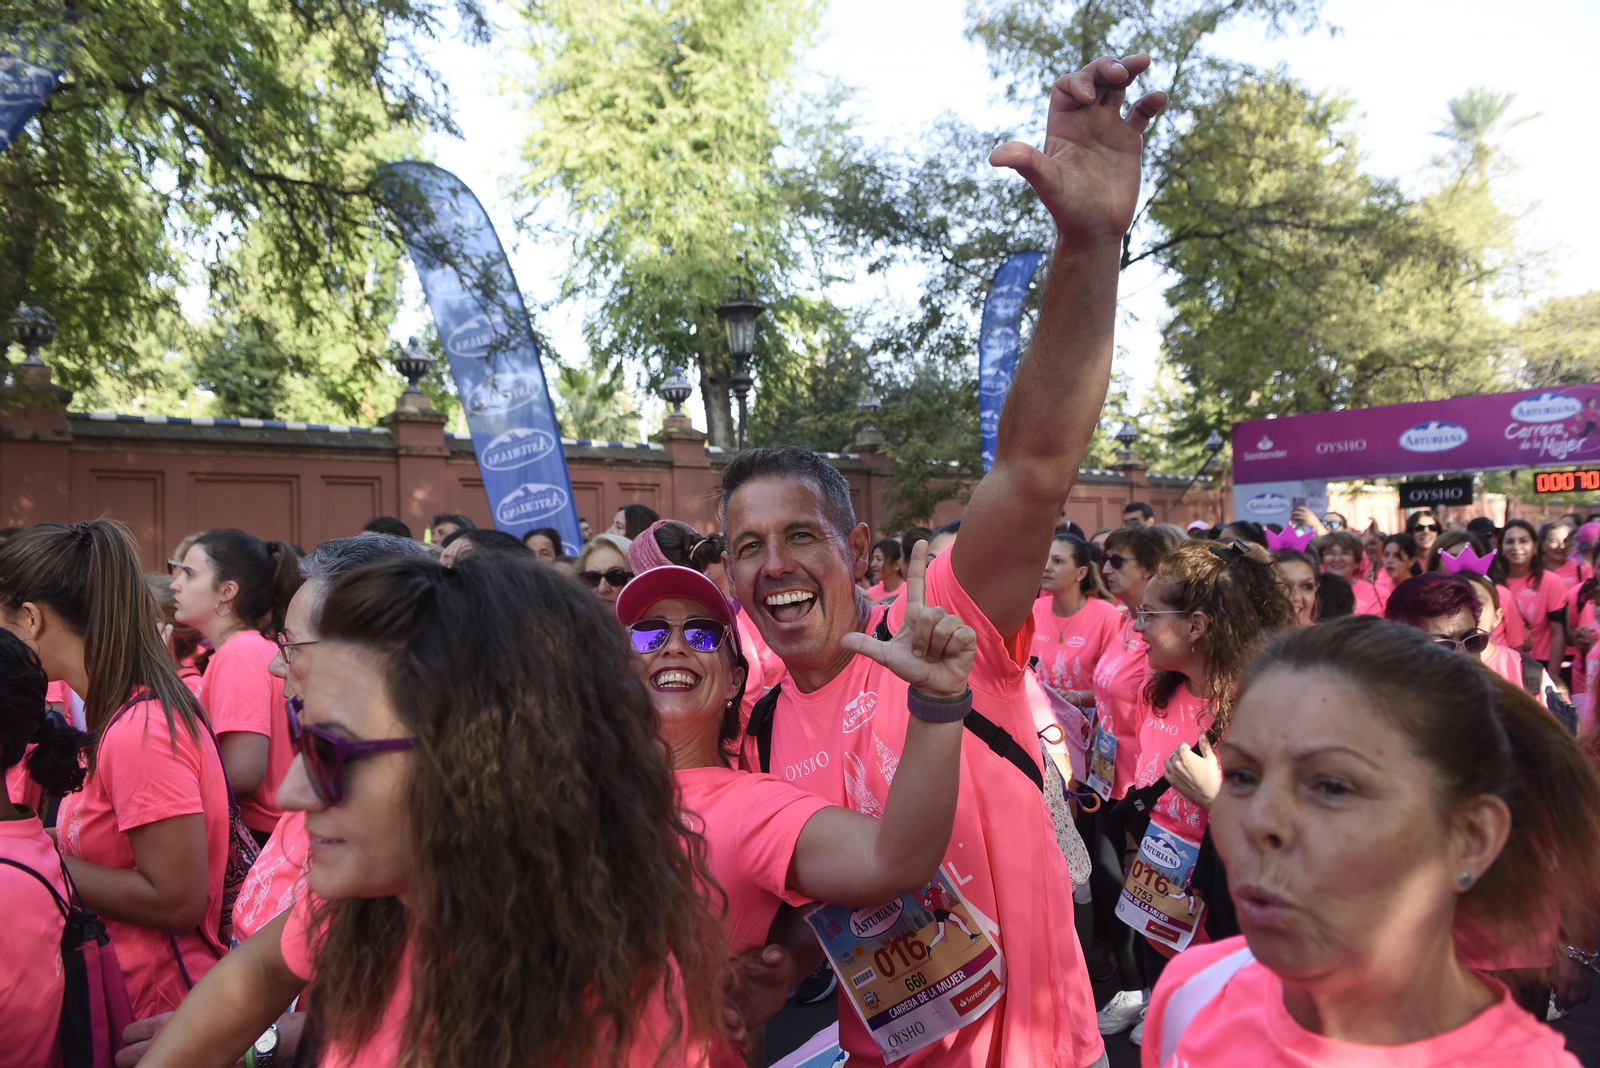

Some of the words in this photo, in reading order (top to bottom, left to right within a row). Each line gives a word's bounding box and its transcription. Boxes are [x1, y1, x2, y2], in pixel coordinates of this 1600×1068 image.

[1404, 434, 1463, 447] ASTURIANA
[1504, 422, 1565, 440] Carrera
[1243, 450, 1288, 461] Santander
[1315, 438, 1367, 455] OYSHO
[1538, 432, 1588, 460] Mujer
[1409, 487, 1463, 501] OYSHO
[785, 750, 829, 782] OYSHO
[1141, 839, 1177, 868] ASTURIANA
[1131, 860, 1170, 894] 016
[1133, 885, 1154, 903] 1753
[852, 900, 901, 936] ASTURIANA
[1133, 896, 1141, 906] DE
[1141, 901, 1149, 911] LA
[1149, 906, 1169, 922] MUJER
[874, 931, 927, 977] 016
[888, 997, 919, 1019] CARRERA
[917, 991, 929, 1003] DE
[926, 989, 937, 998] LA
[936, 970, 967, 993] MUJER
[904, 971, 927, 992] 660
[966, 980, 992, 1004] Santander
[887, 1021, 926, 1048] OYSHO
